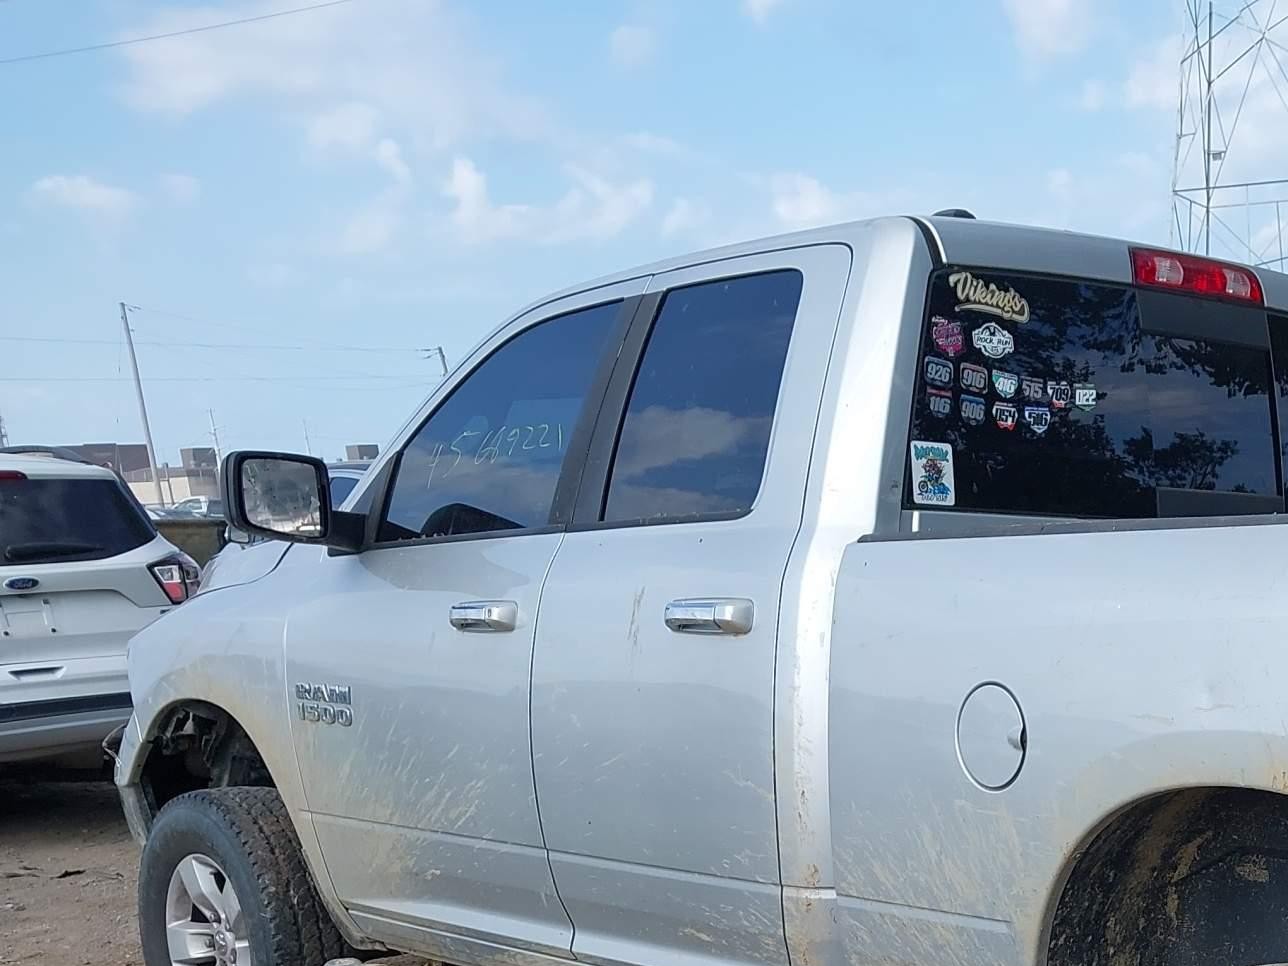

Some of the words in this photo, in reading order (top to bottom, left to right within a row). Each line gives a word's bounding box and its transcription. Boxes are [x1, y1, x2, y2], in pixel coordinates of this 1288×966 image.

[948, 271, 1028, 321] Vikings
[927, 363, 951, 383] 926
[962, 368, 986, 389] 916
[1021, 380, 1044, 399] 515
[1049, 386, 1070, 402] 709
[295, 682, 352, 706] RAM
[296, 701, 353, 727] 1500
